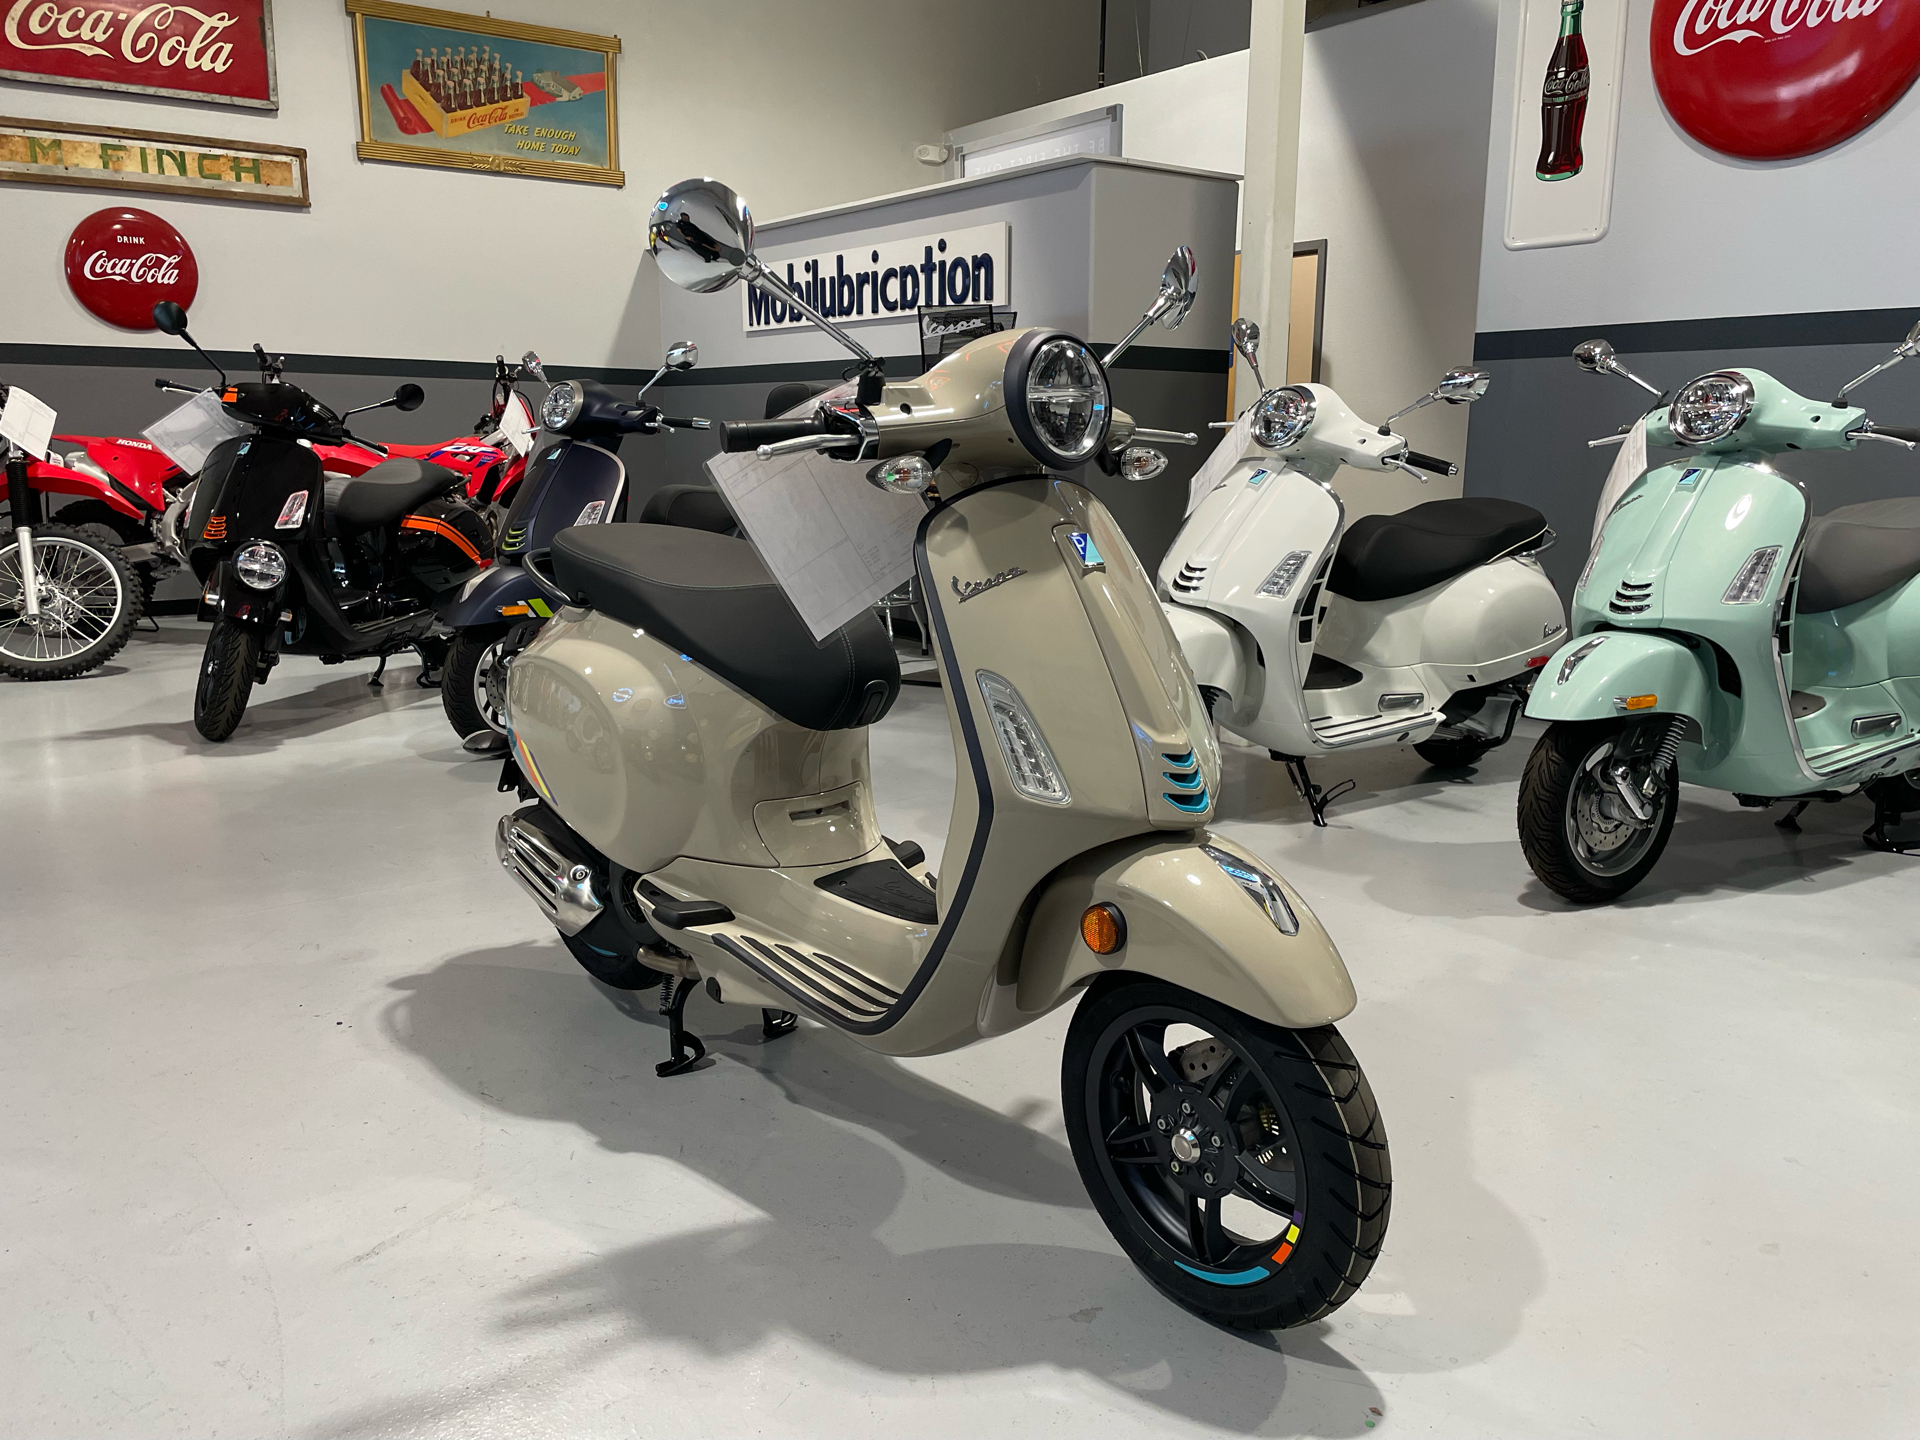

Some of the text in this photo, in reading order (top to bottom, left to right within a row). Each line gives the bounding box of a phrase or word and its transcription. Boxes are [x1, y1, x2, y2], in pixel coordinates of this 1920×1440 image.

[5, 0, 239, 73] Coca-Cola
[504, 123, 577, 141] TAKE ENOUGH
[516, 140, 581, 156] HOME TODAY
[100, 142, 261, 184] FINCH
[116, 235, 146, 245] DRINK
[83, 250, 182, 285] Coca-Cola
[922, 315, 986, 340] Vespa
[116, 439, 152, 450] HONDA
[951, 567, 1028, 604] Vespa
